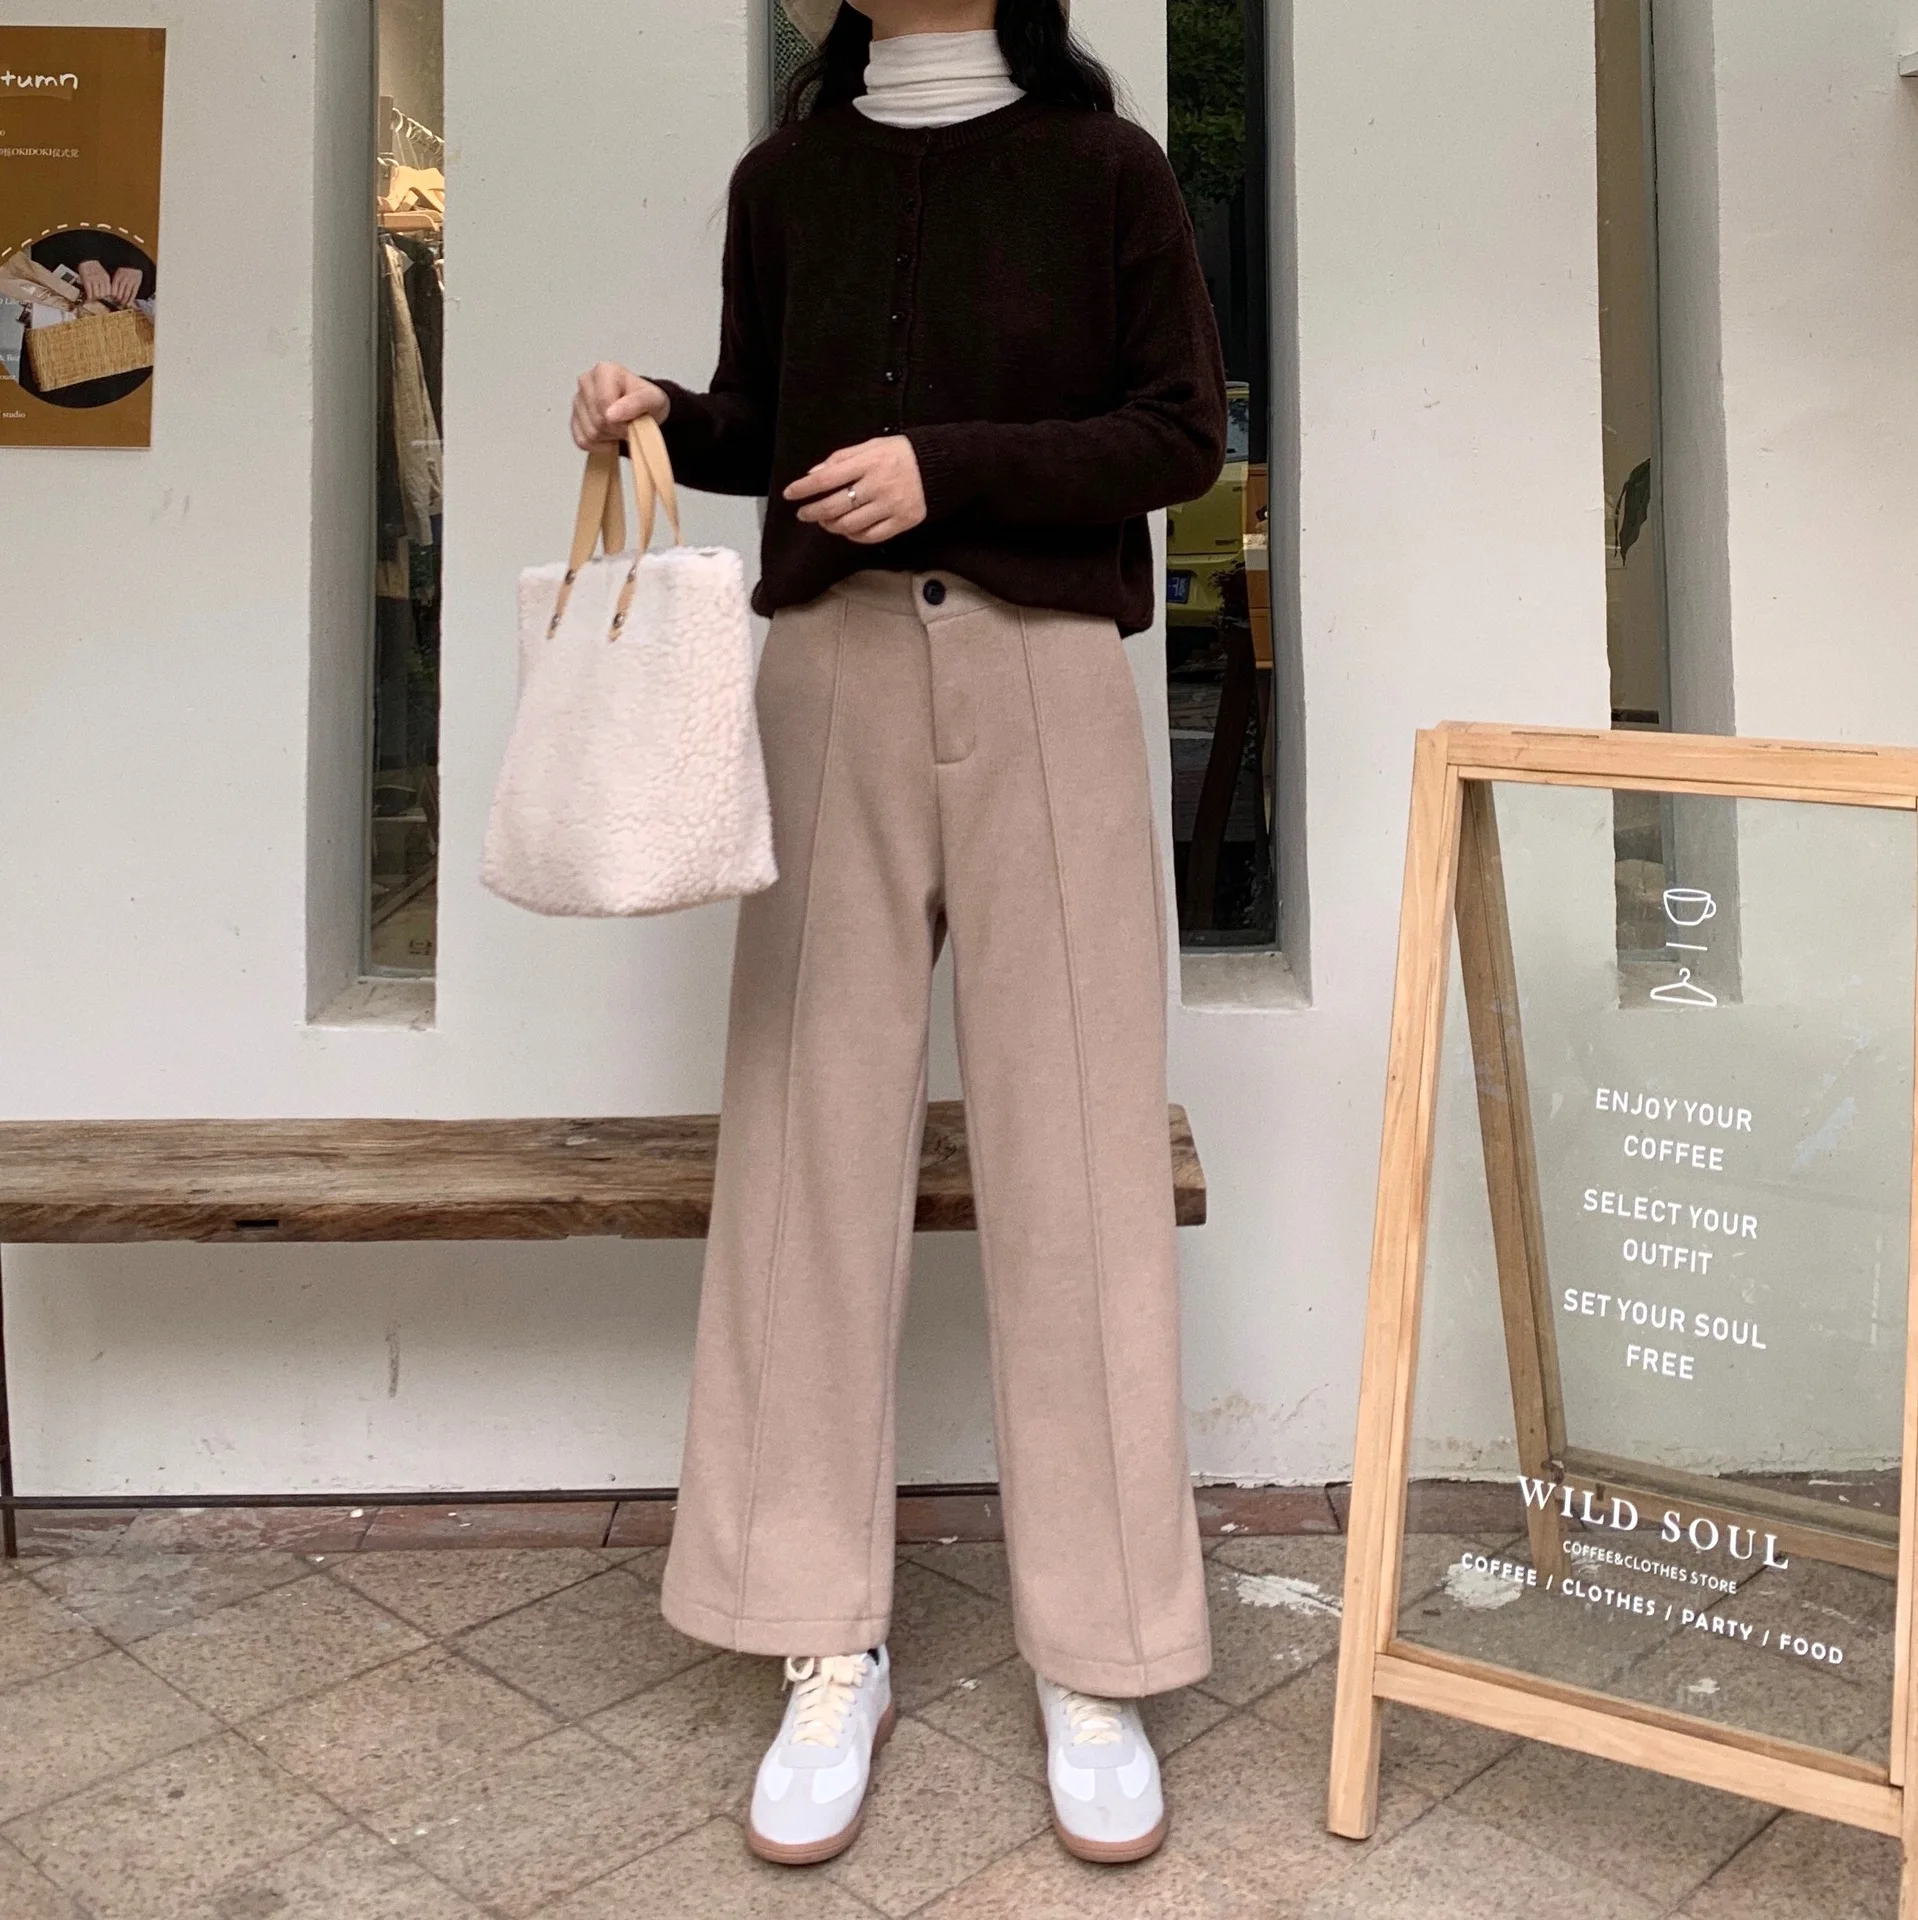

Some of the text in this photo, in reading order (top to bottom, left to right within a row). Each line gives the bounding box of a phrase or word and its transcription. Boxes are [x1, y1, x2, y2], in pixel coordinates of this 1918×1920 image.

[1596, 1087, 1752, 1132] ENJOY YOUR
[1624, 1135, 1724, 1171] COFFEE
[1583, 1189, 1758, 1239] SELECT YOUR
[1623, 1238, 1713, 1275] OUTFIT
[1563, 1288, 1767, 1350] SET YOUR SOUL
[1626, 1344, 1695, 1380] FREE
[1516, 1475, 1789, 1570] WILD SOUL
[1562, 1540, 1738, 1595] COFFEE&CLOTHES STORE
[1461, 1552, 1538, 1586] COFFEE
[1562, 1578, 1657, 1617] CLOTHES
[1681, 1608, 1753, 1641] PARTY
[1779, 1632, 1844, 1665] FOOD
